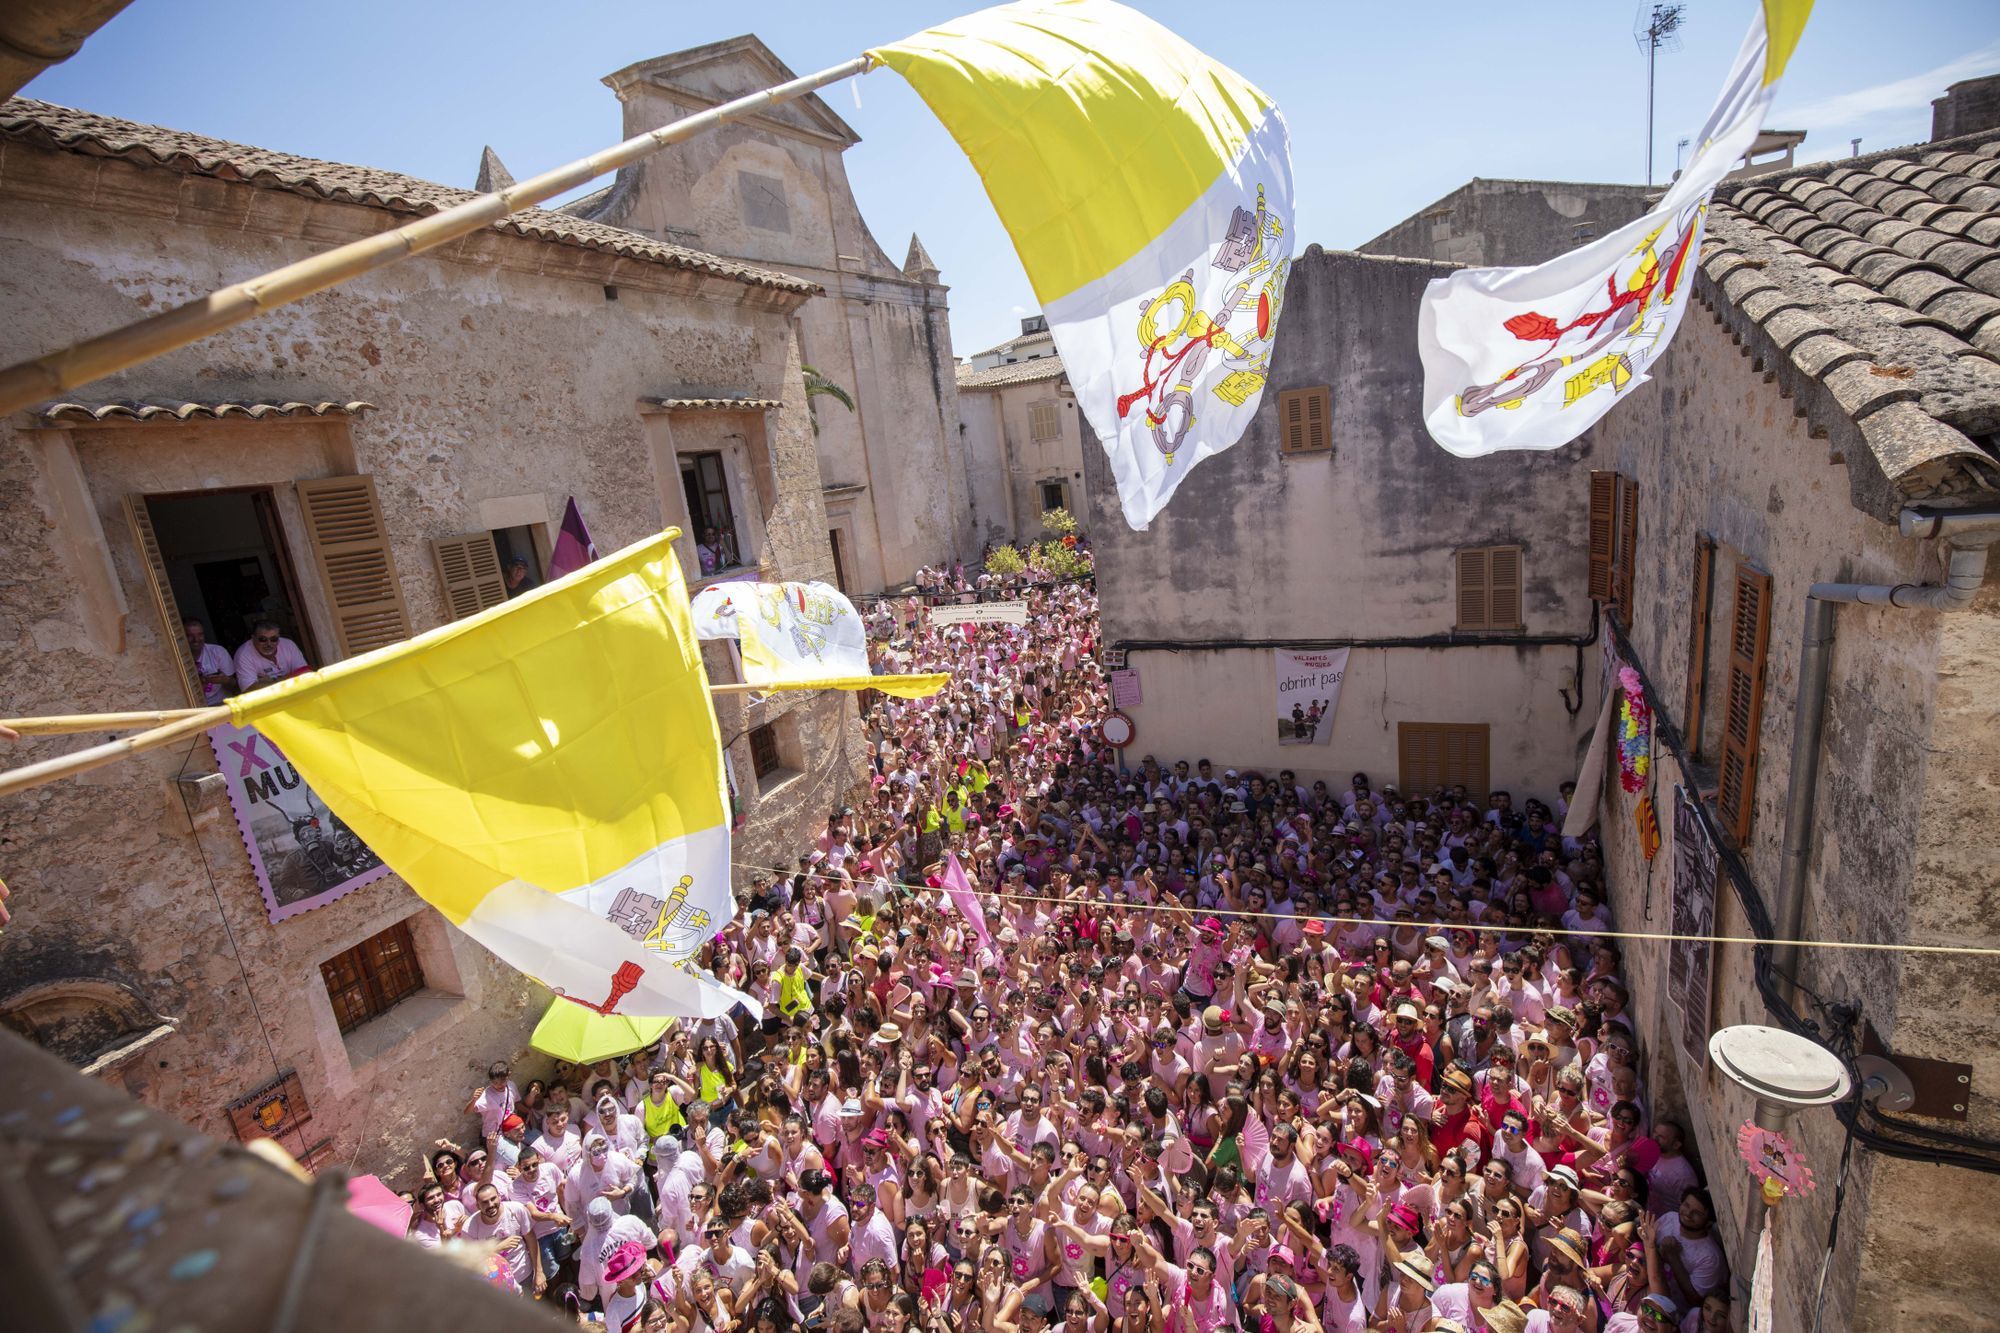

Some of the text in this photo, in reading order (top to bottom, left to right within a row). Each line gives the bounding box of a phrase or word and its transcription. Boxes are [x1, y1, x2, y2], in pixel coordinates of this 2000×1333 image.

[1280, 672, 1344, 692] obrint pas
[238, 1076, 290, 1111] AJUNTAMENT
